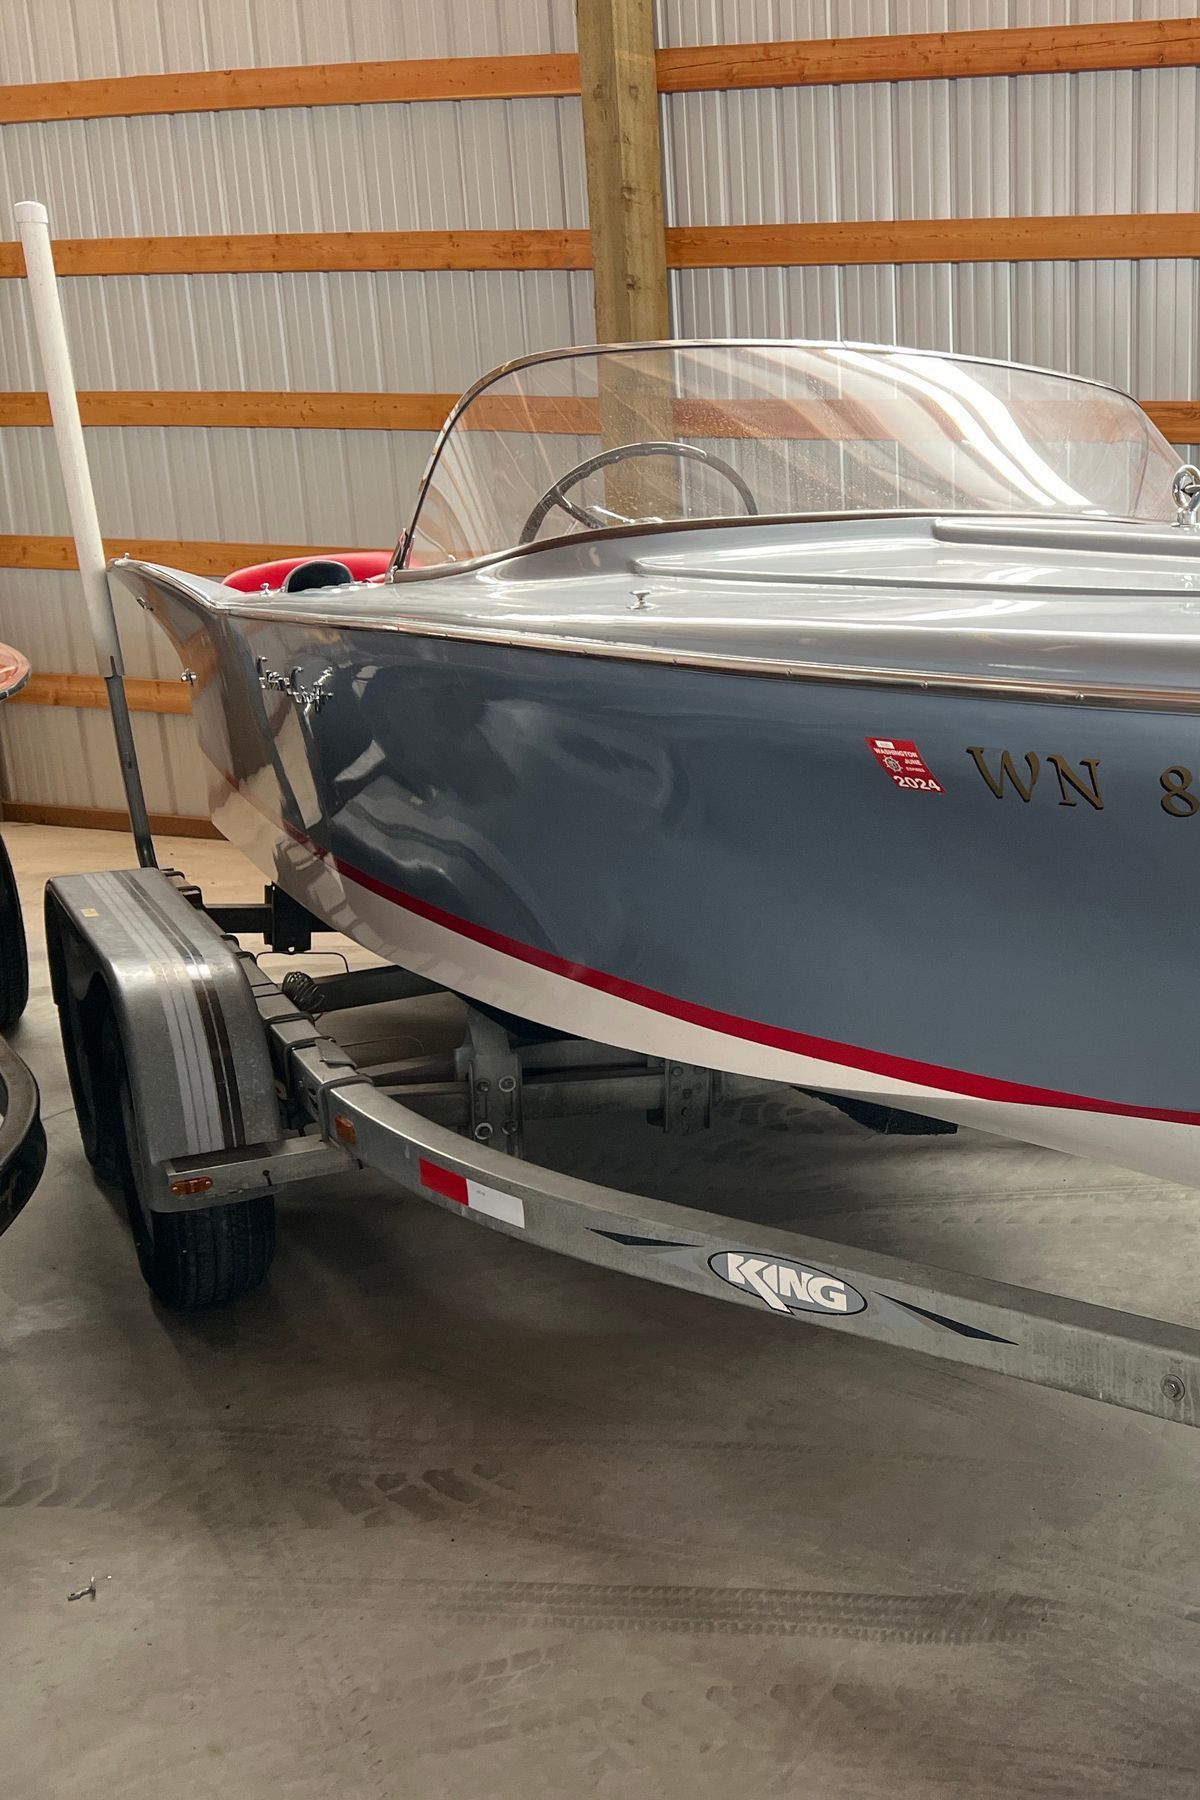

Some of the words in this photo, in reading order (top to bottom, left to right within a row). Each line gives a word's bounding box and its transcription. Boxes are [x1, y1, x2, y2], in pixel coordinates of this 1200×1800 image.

[873, 747, 918, 758] WASHINGTON
[892, 775, 941, 792] 2024
[965, 746, 1104, 810] WN
[727, 1252, 848, 1314] KING
